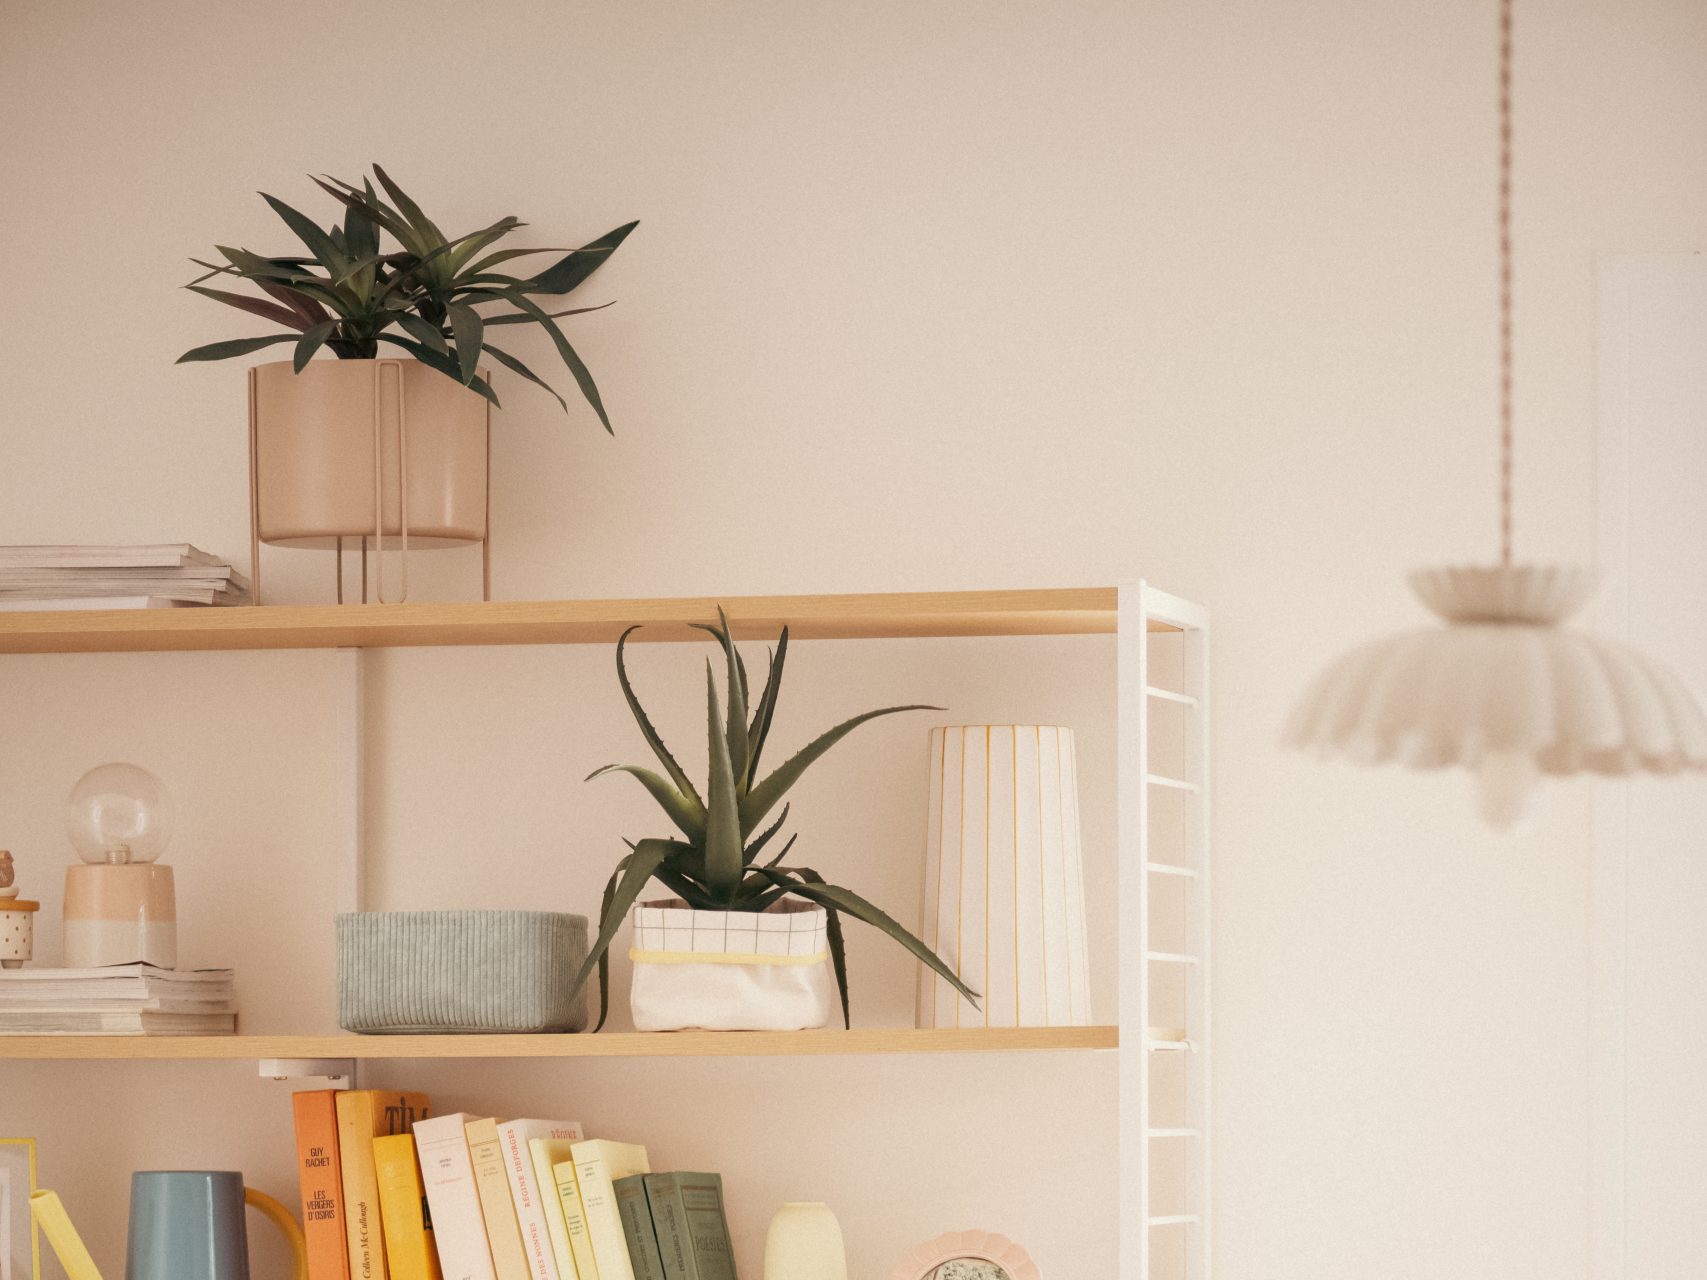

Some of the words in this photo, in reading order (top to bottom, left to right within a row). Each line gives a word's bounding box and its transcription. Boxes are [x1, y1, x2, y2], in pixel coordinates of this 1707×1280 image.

[310, 1147, 324, 1157] GUY
[507, 1128, 522, 1173] DEFORGES
[305, 1157, 330, 1168] RACHET
[313, 1190, 326, 1200] LES
[519, 1175, 531, 1208] RÉGINE
[306, 1199, 335, 1211] VERGERS
[529, 1222, 542, 1258] NONNES
[362, 1251, 371, 1279] Colleen
[537, 1258, 546, 1275] DES
